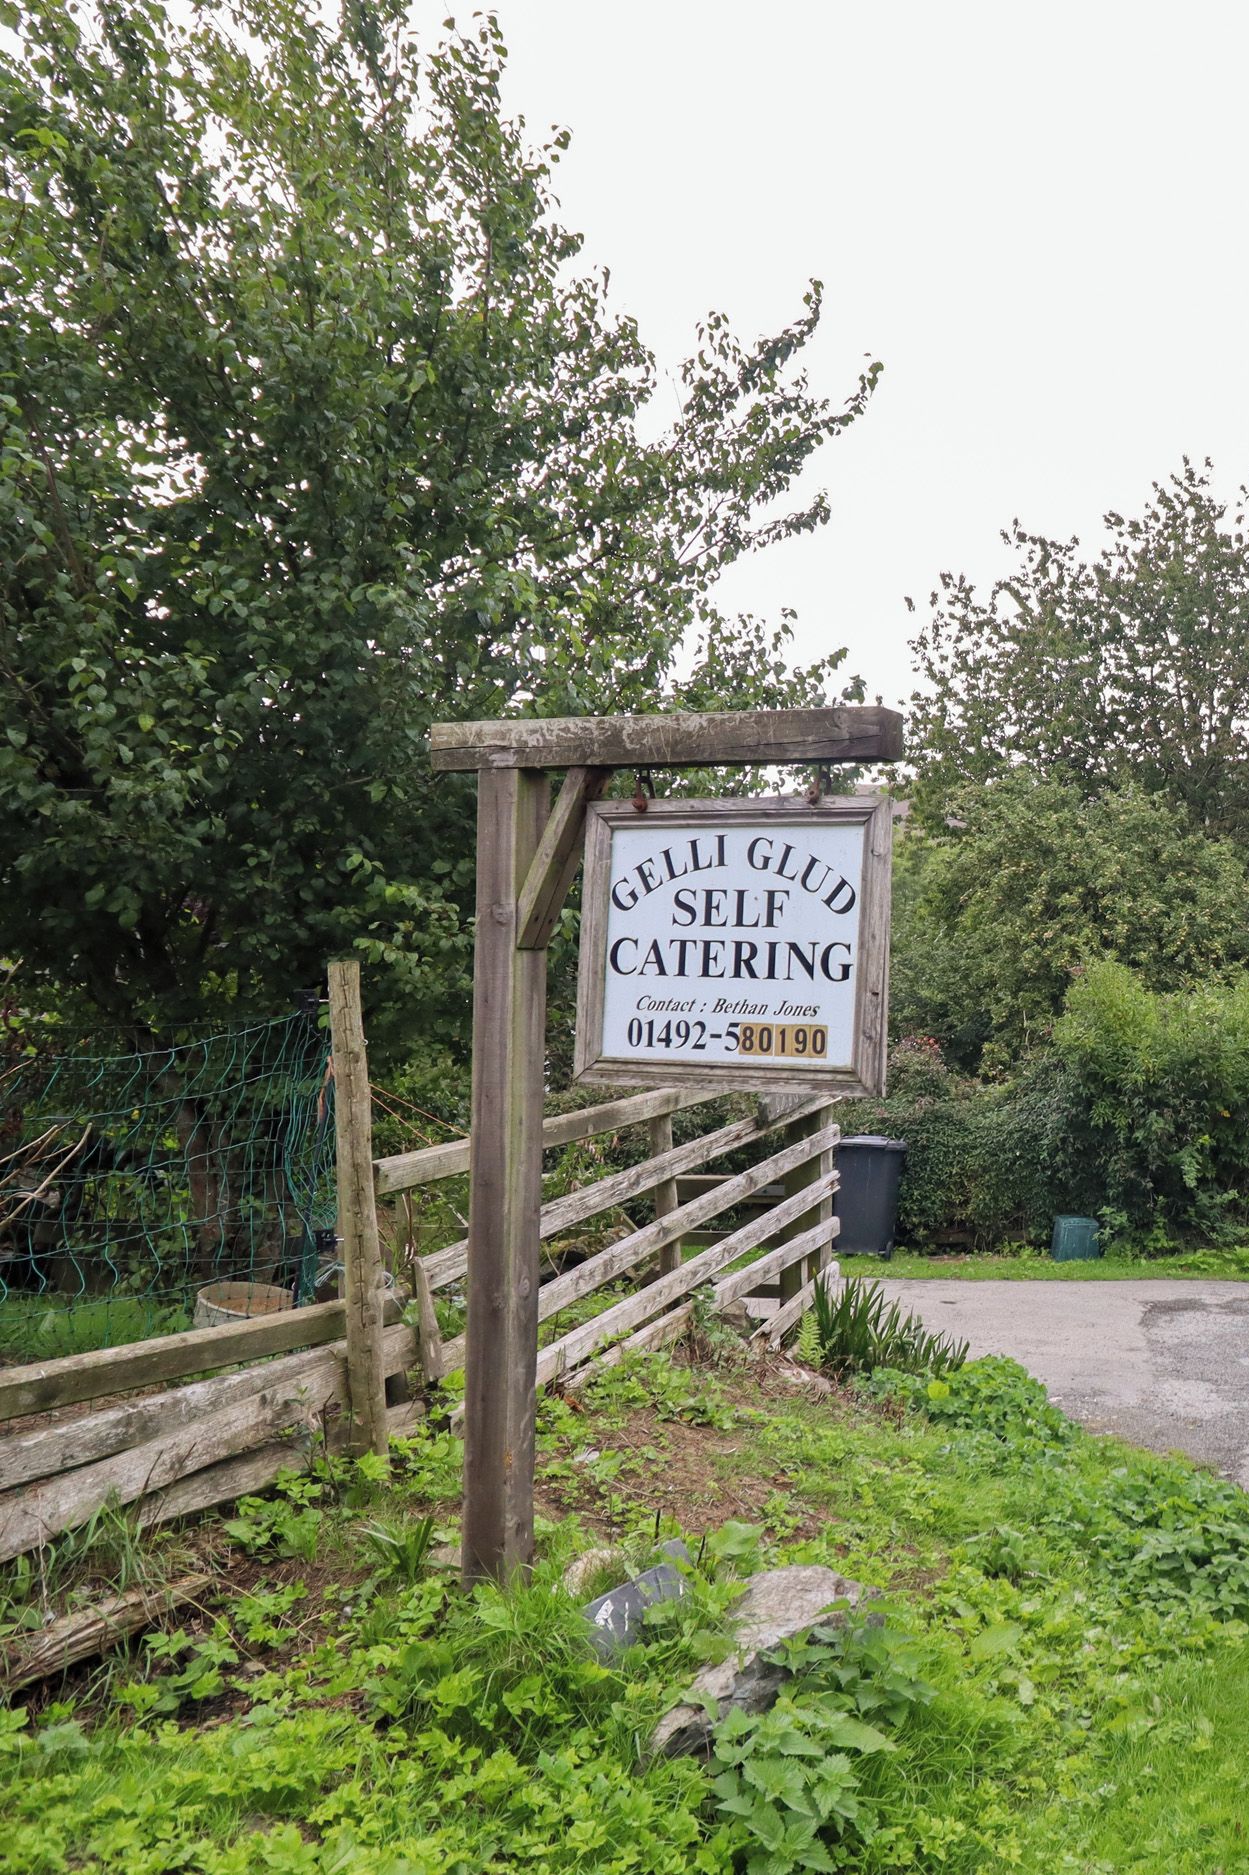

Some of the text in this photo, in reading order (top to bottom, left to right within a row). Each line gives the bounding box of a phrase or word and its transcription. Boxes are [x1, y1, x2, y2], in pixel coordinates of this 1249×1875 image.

[611, 834, 856, 915] GELLI GLUD
[672, 888, 790, 928] SELF
[609, 937, 853, 982] CATERING
[636, 995, 697, 1013] Contact
[712, 998, 768, 1015] Bethan
[773, 1000, 820, 1017] Jones
[627, 1017, 826, 1055] 01492-580190
